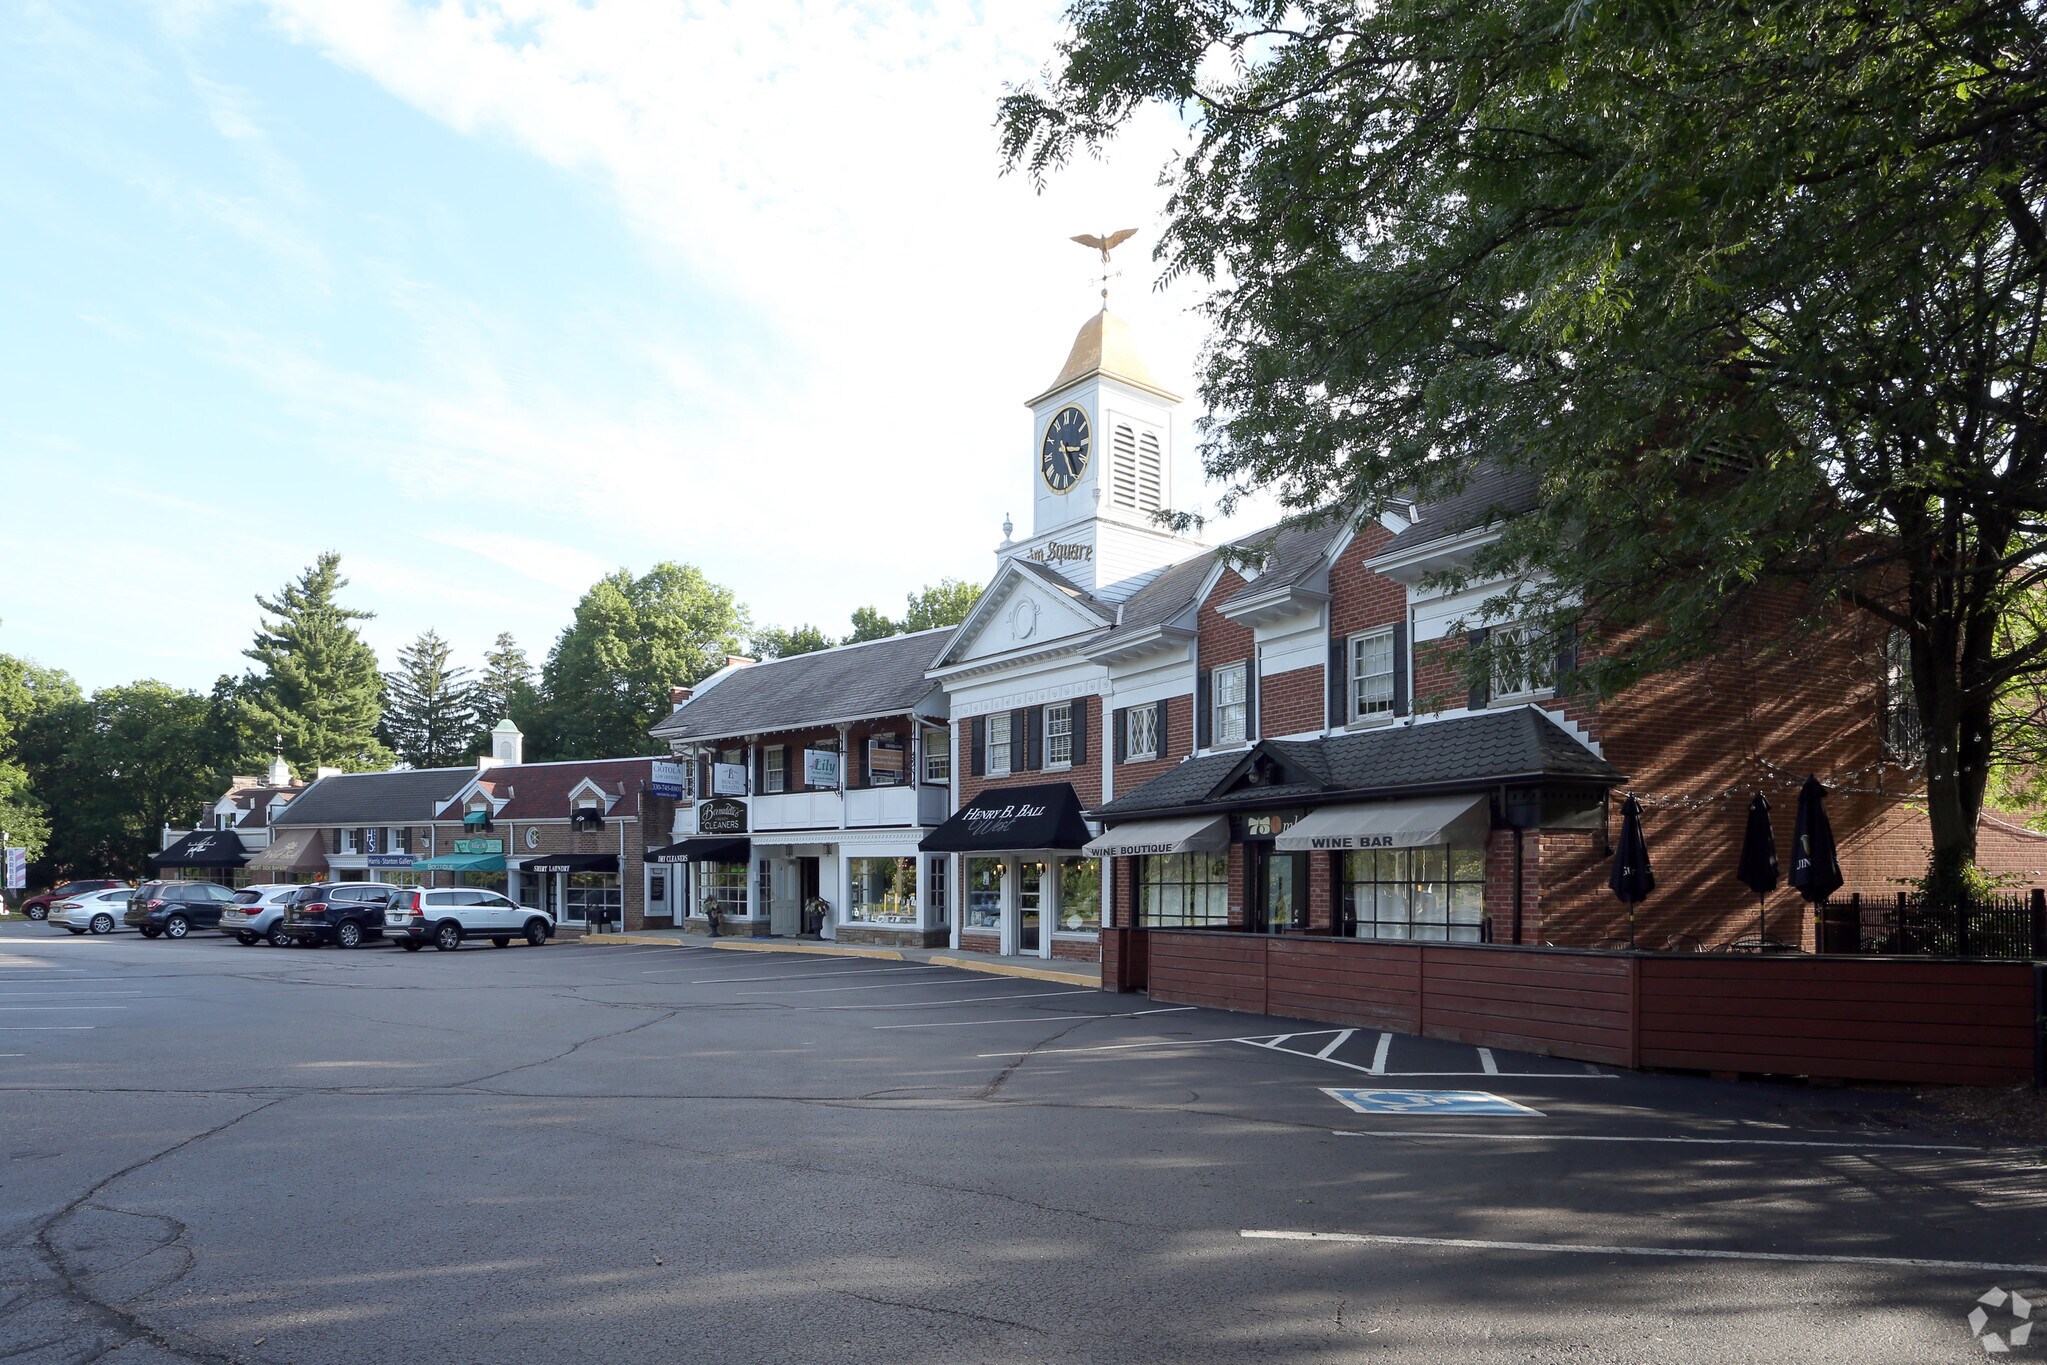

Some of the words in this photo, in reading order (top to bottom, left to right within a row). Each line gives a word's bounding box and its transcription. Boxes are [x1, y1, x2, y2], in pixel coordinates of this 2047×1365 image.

[1046, 436, 1055, 445] X
[1045, 541, 1094, 566] Square
[653, 765, 682, 775] CIOTOLA
[815, 758, 836, 776] Lily
[999, 805, 1015, 819] B.
[704, 820, 740, 830] CLEANERS
[968, 817, 1016, 836] West
[1311, 837, 1352, 848] WINE
[1360, 836, 1393, 847] BAR
[1091, 847, 1117, 856] WINE
[1120, 843, 1173, 855] BOUTIQUE
[657, 855, 666, 863] DRY
[666, 854, 688, 863] CLEANERS
